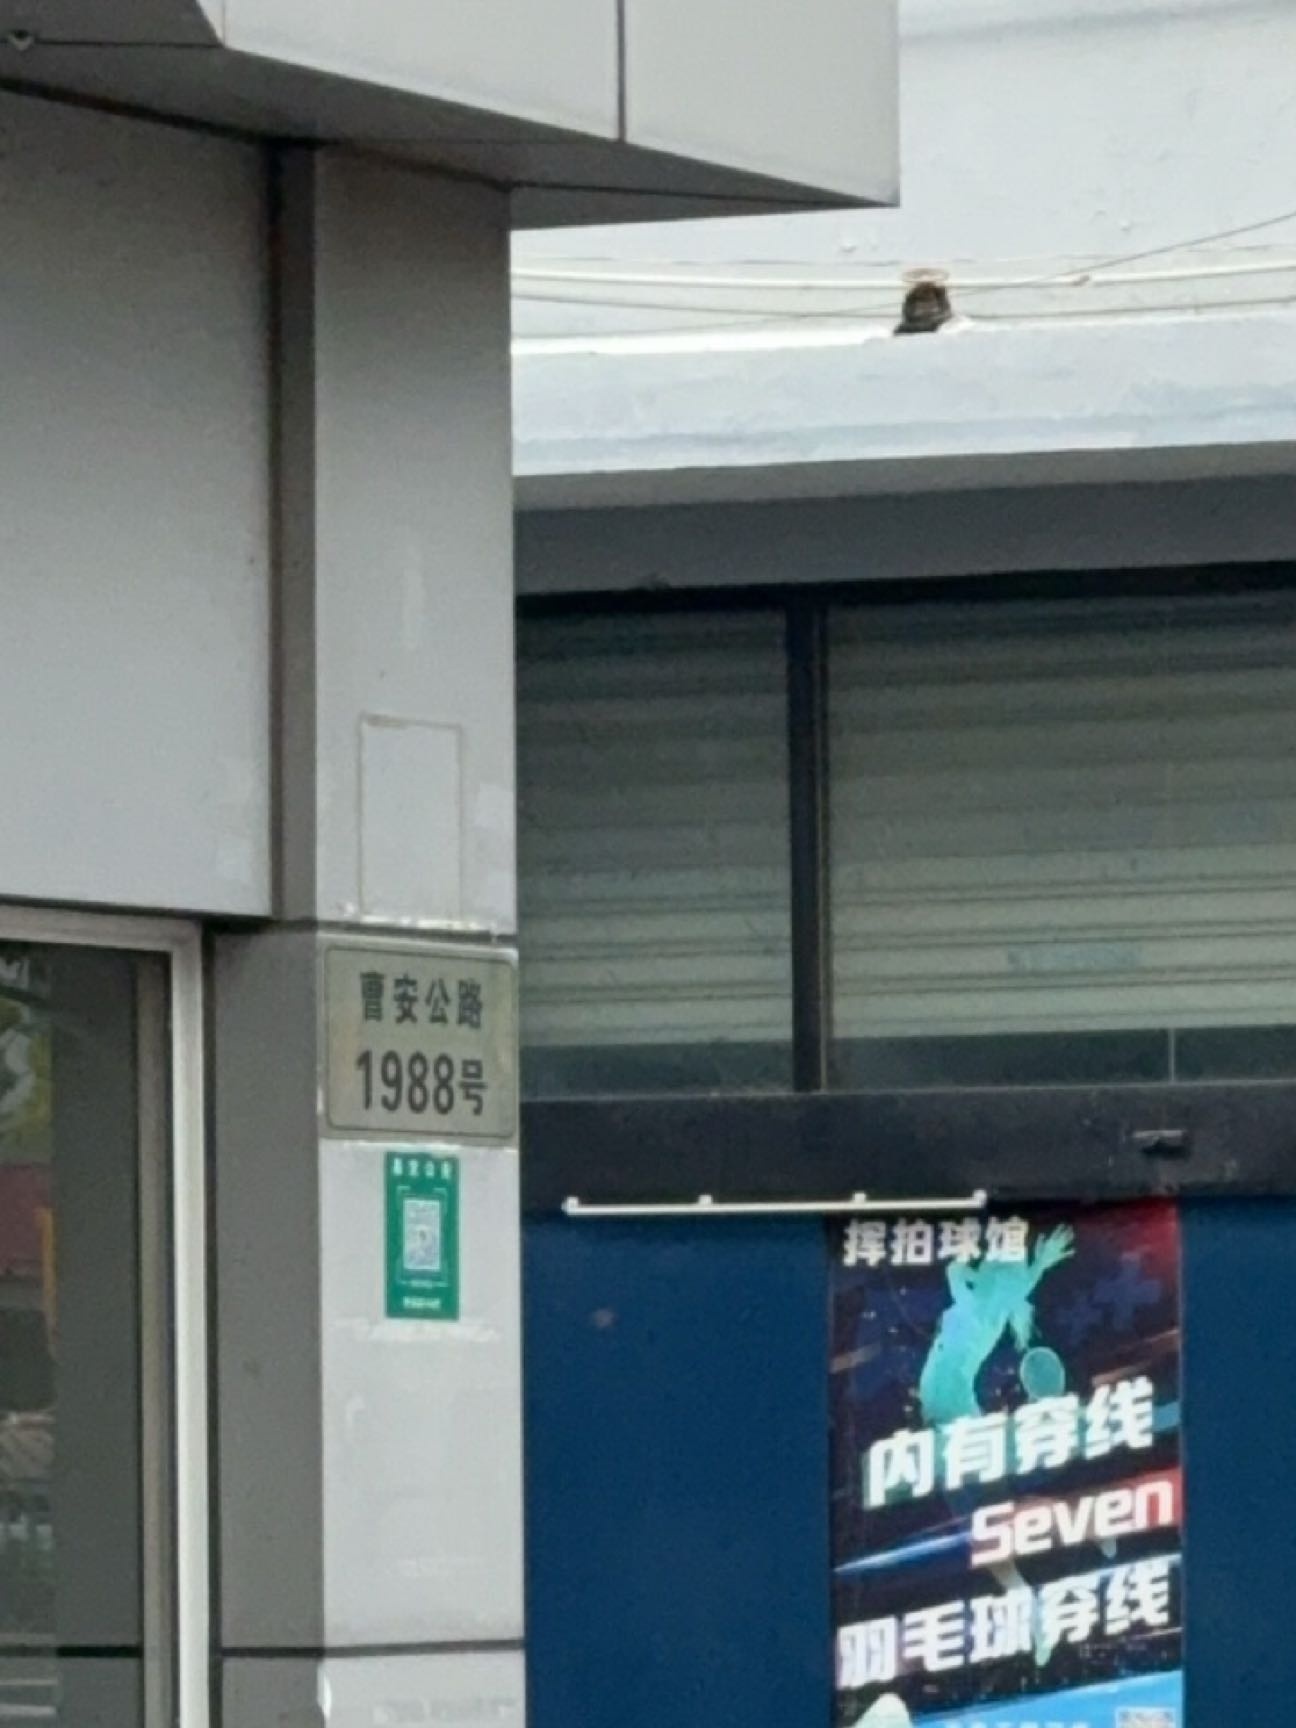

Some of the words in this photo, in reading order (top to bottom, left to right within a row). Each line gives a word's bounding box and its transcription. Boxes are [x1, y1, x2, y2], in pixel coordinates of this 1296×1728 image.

[360, 971, 483, 1030] 曹安公路
[355, 1050, 488, 1117] 1988号
[842, 1215, 1030, 1268] 挥拍球馆
[863, 1375, 1155, 1511] 内有穿线
[970, 1478, 1174, 1569] Seven
[836, 1559, 1172, 1692] 羽毛球穿线
